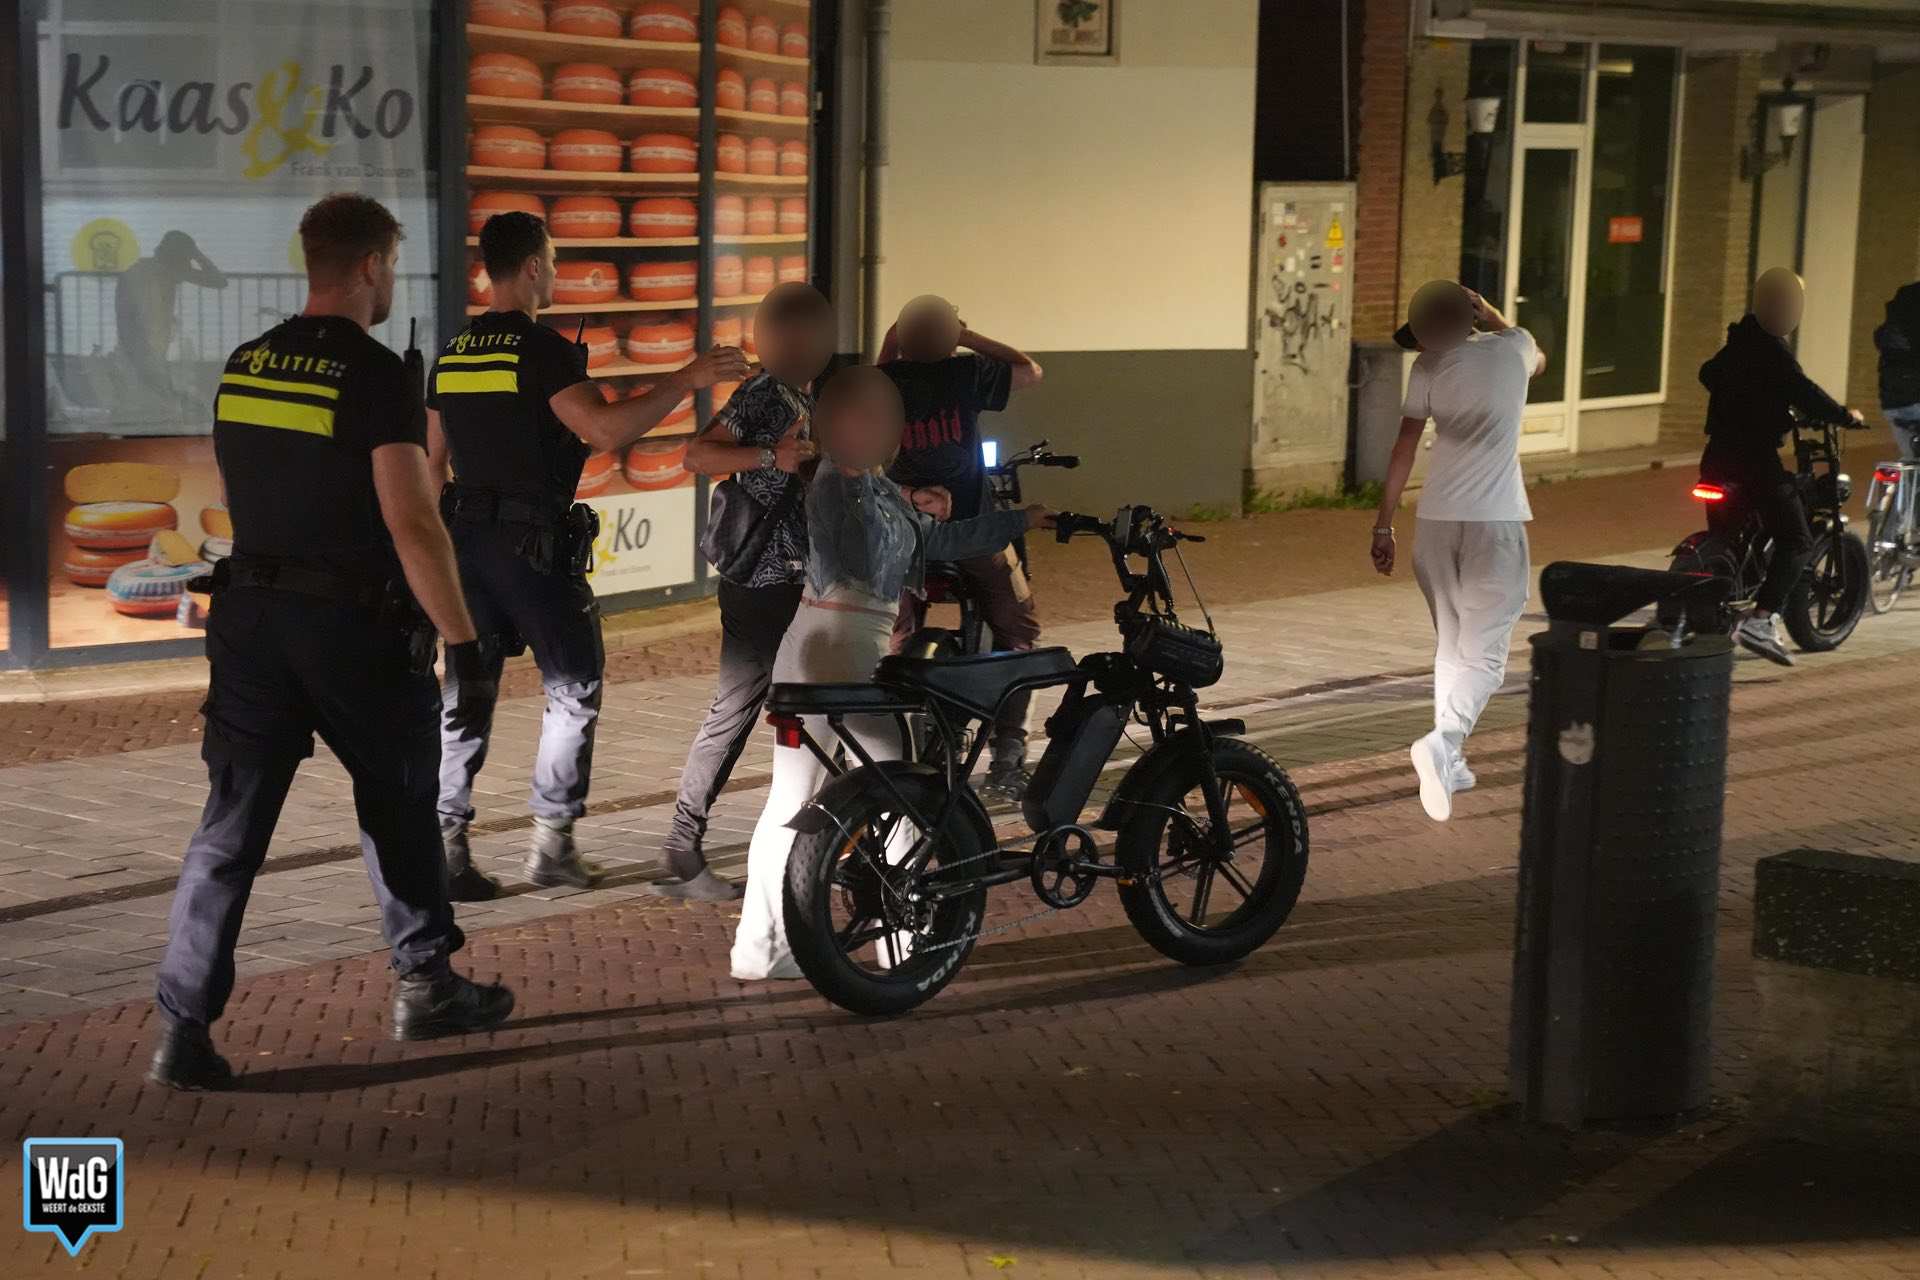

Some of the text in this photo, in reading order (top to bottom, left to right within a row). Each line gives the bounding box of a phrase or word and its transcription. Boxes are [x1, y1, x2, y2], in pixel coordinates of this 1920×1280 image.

[447, 331, 514, 354] POLITIE
[239, 343, 330, 375] POLITIE
[1264, 771, 1303, 855] KENDA
